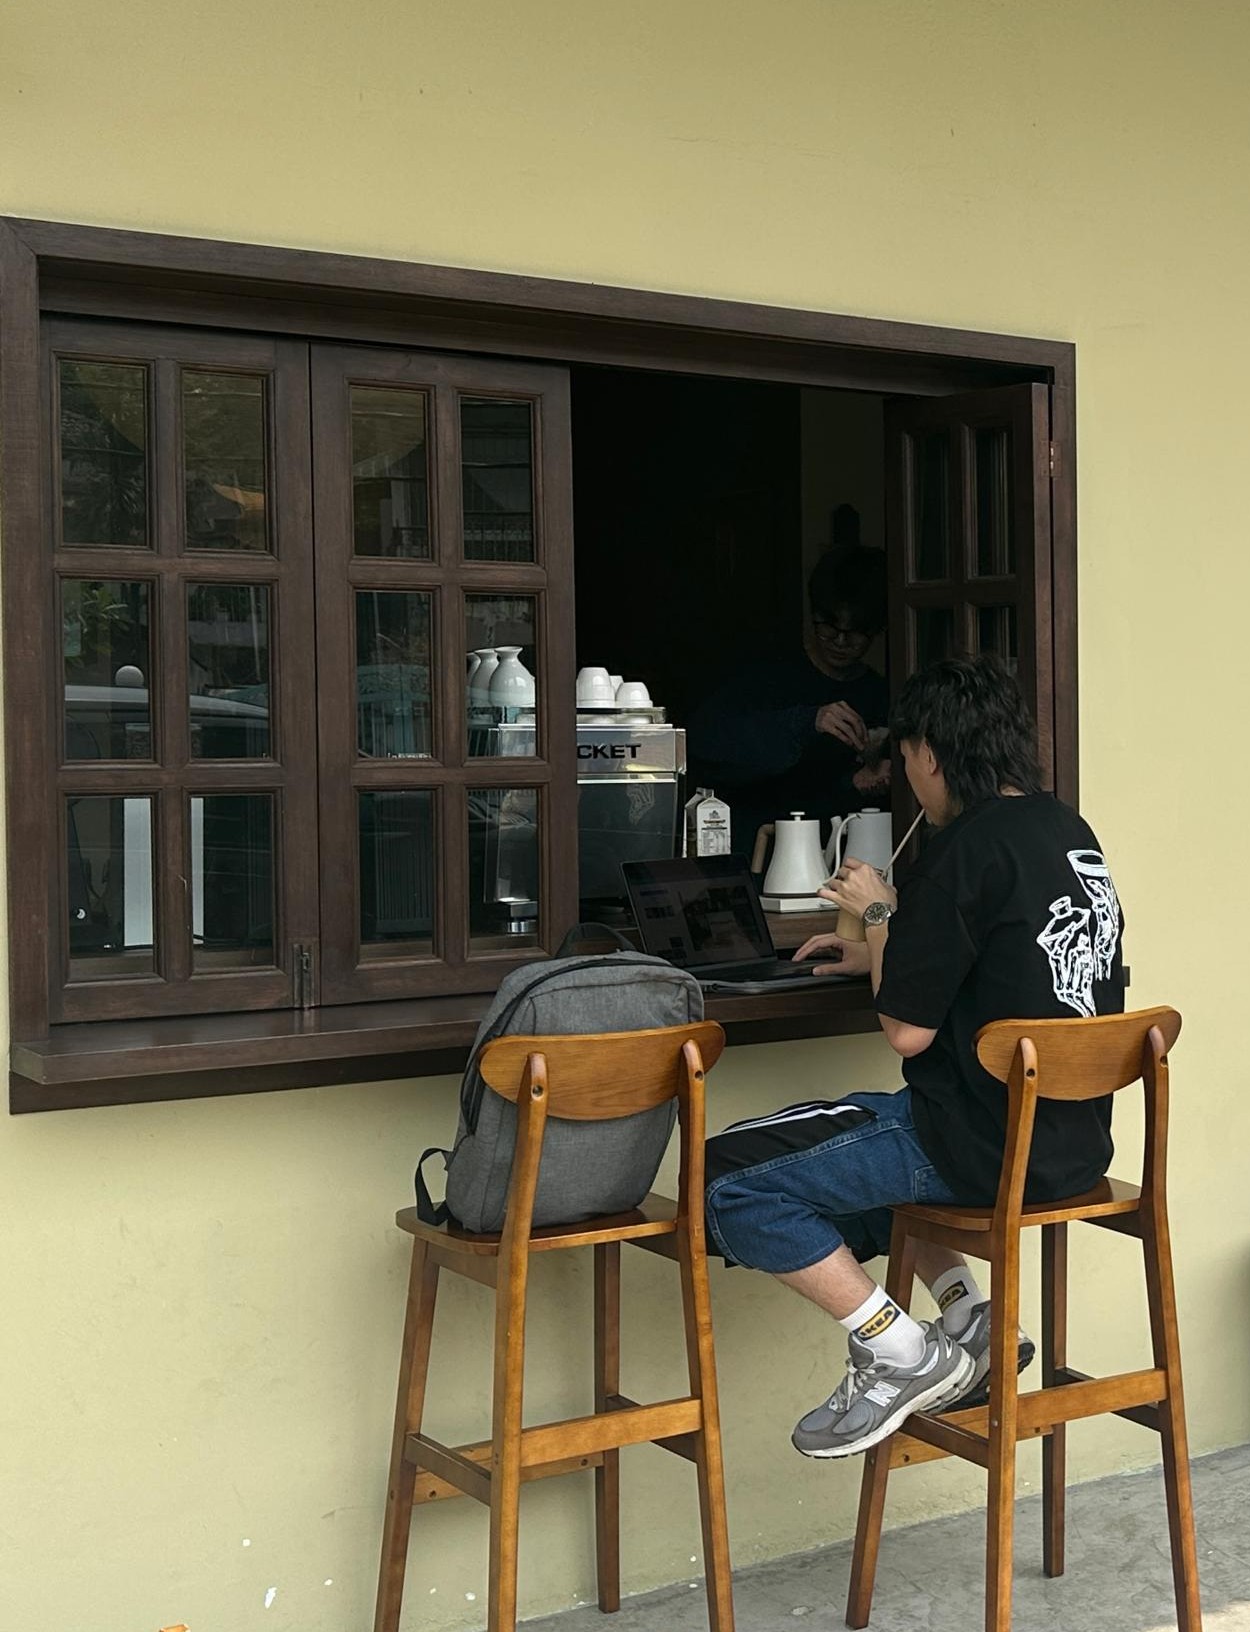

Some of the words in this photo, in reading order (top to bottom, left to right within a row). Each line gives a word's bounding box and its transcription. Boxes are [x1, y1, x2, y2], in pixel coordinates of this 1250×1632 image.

[577, 744, 641, 759] CKET
[860, 1309, 893, 1336] IKEA
[864, 1380, 901, 1407] N
